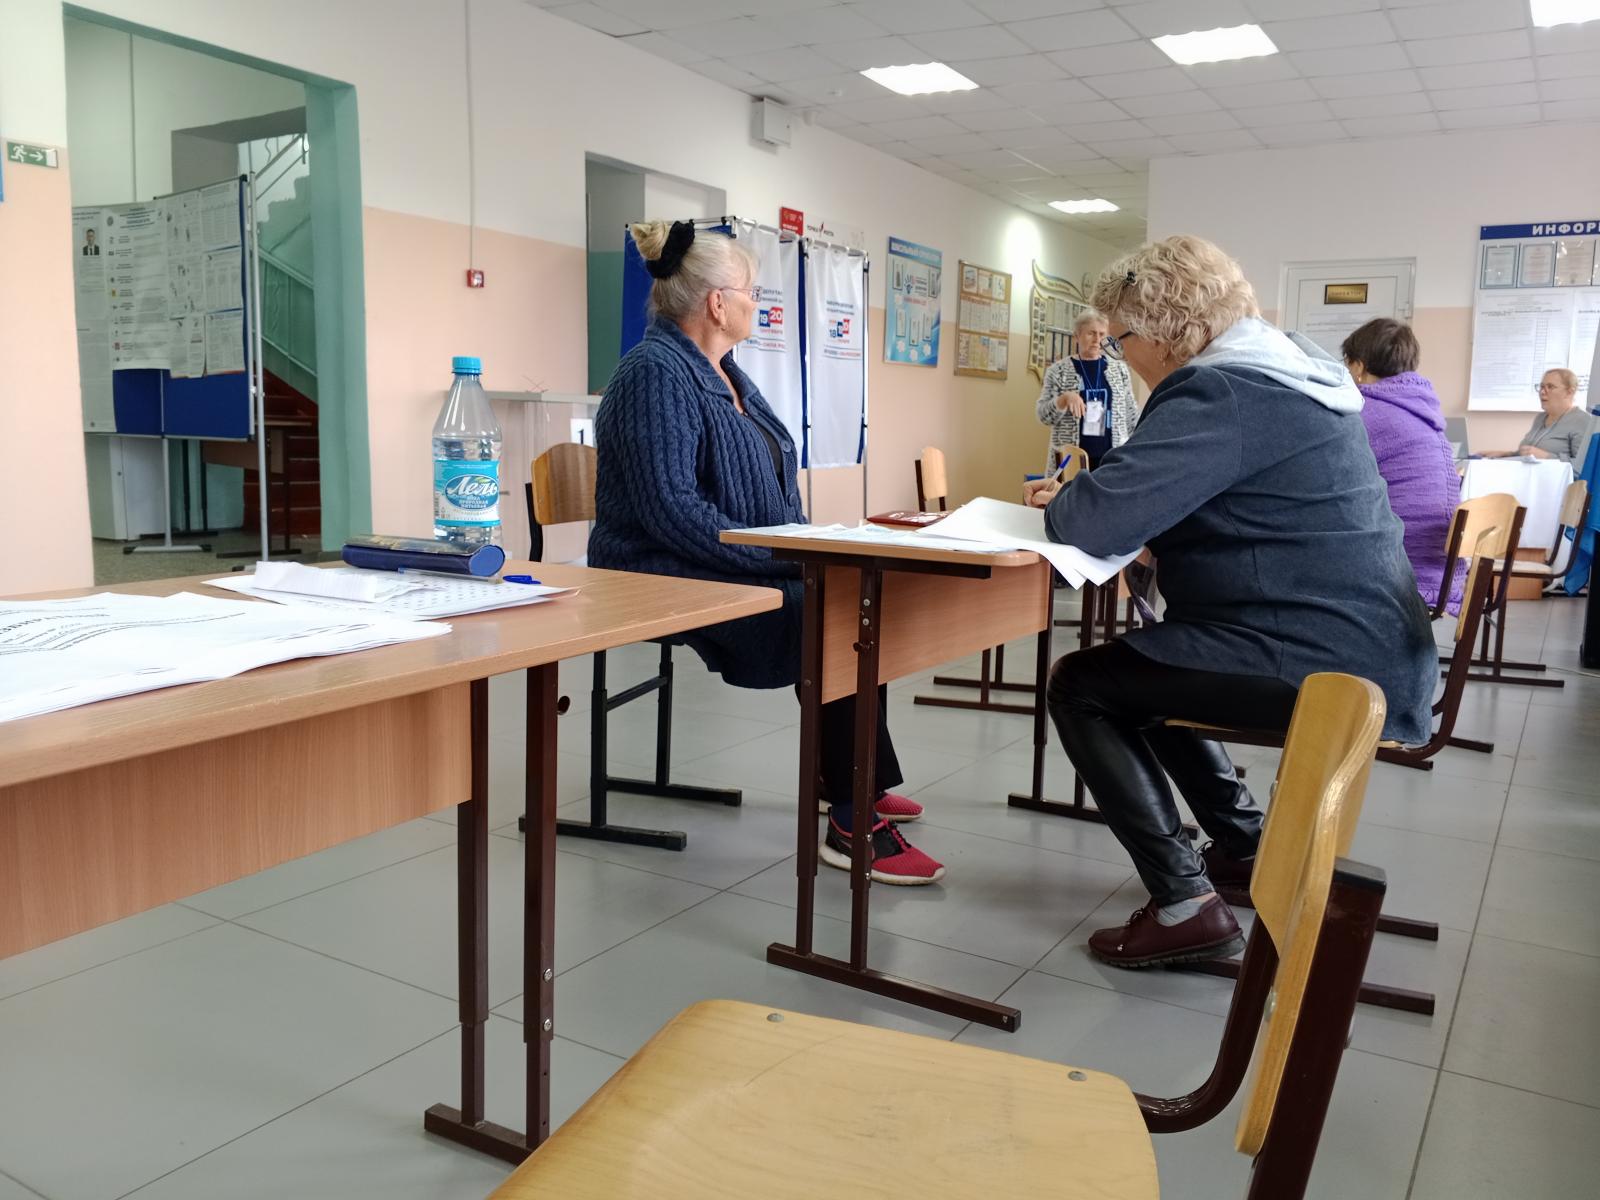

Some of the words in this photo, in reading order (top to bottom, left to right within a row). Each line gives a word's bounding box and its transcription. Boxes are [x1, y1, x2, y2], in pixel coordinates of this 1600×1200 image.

[1532, 222, 1600, 236] ИНФОР
[760, 313, 768, 323] 19
[769, 310, 782, 321] 20
[578, 428, 584, 444] 1
[447, 477, 498, 495] Лель
